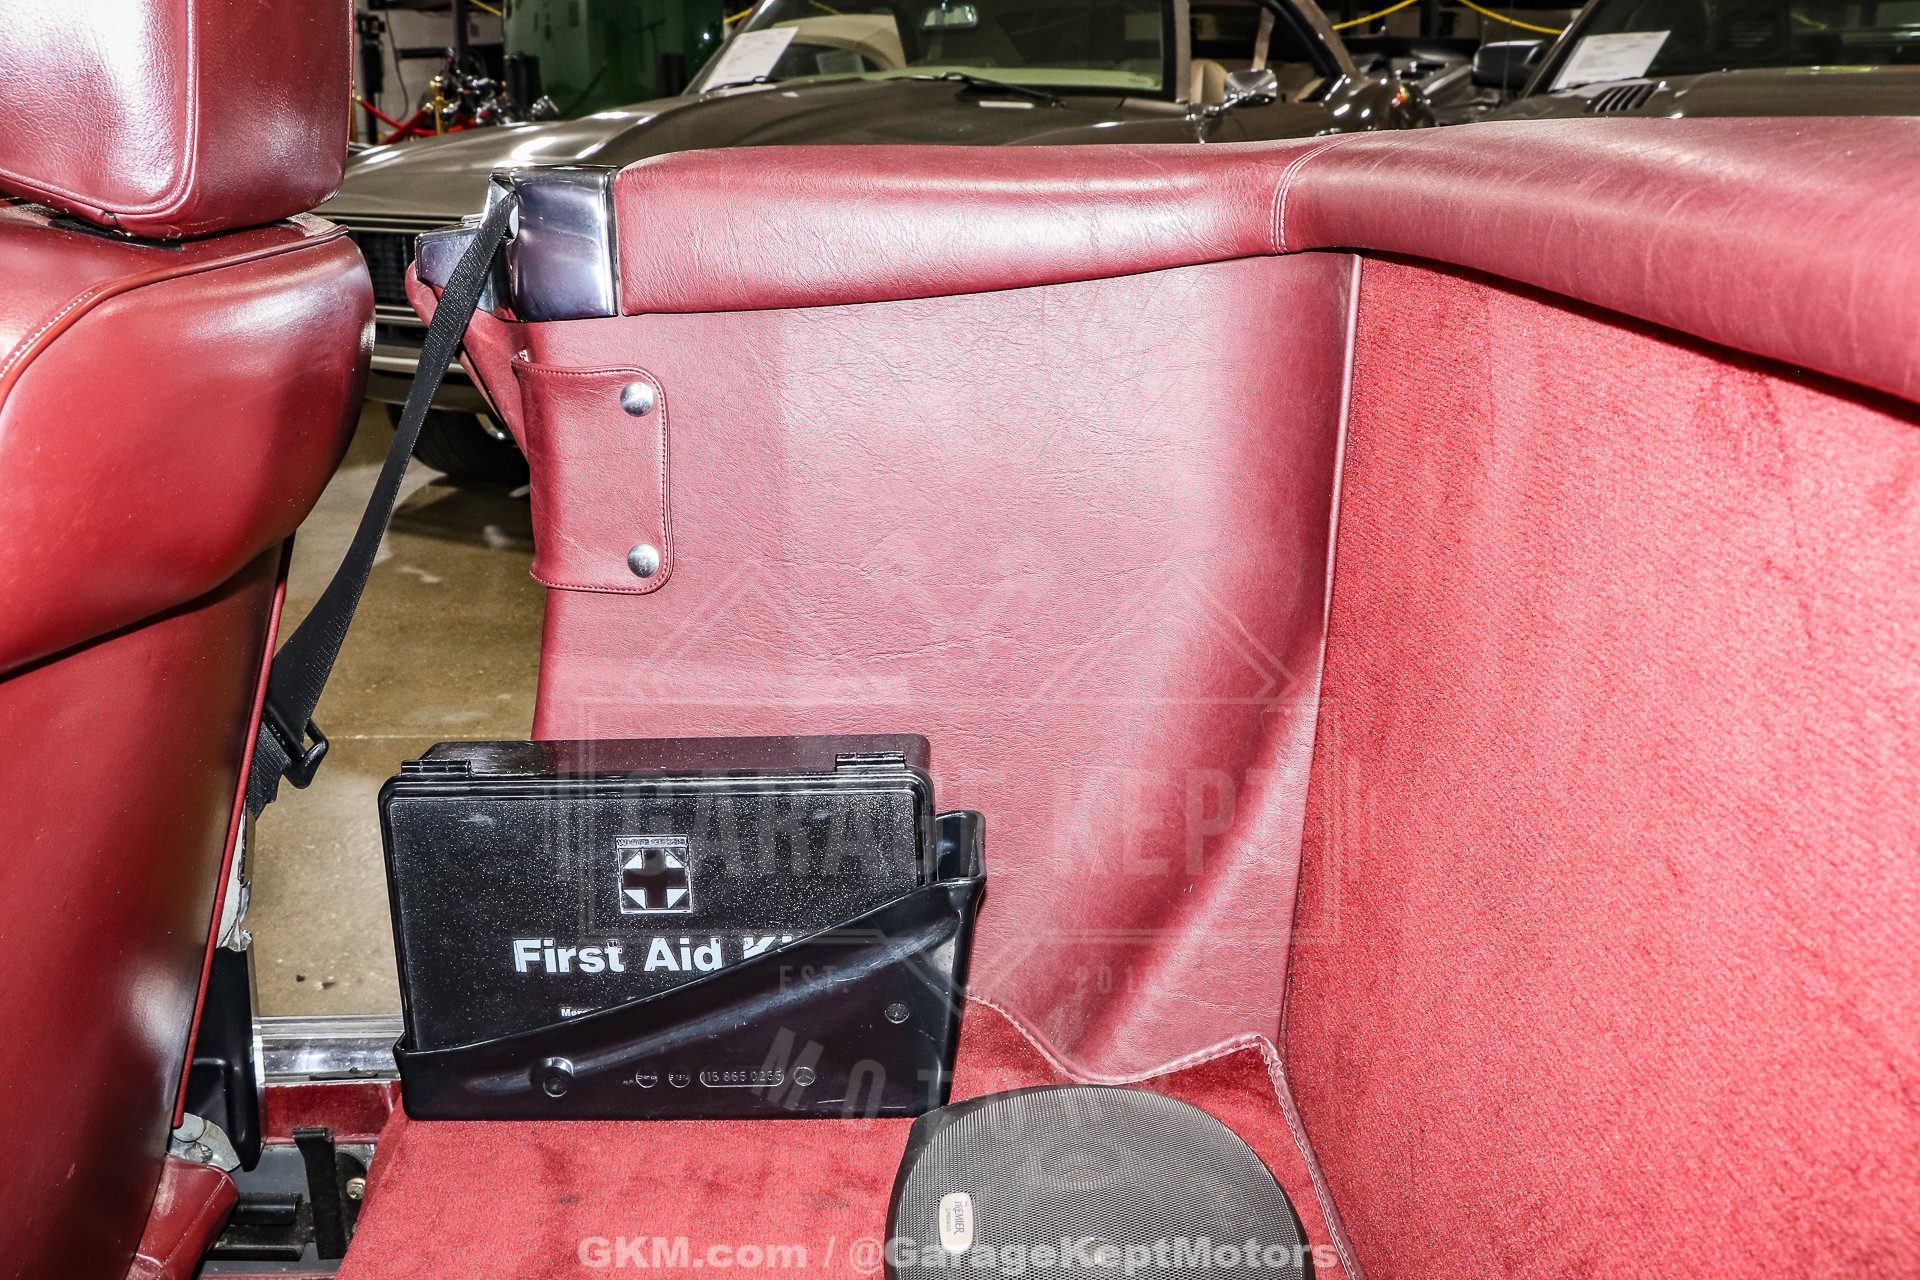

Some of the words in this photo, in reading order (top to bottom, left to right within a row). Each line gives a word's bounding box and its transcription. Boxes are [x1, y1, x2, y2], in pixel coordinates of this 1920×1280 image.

[513, 938, 625, 973] First
[643, 937, 724, 973] Aid
[722, 1071, 747, 1082] 865
[953, 1201, 967, 1235] PREMIER
